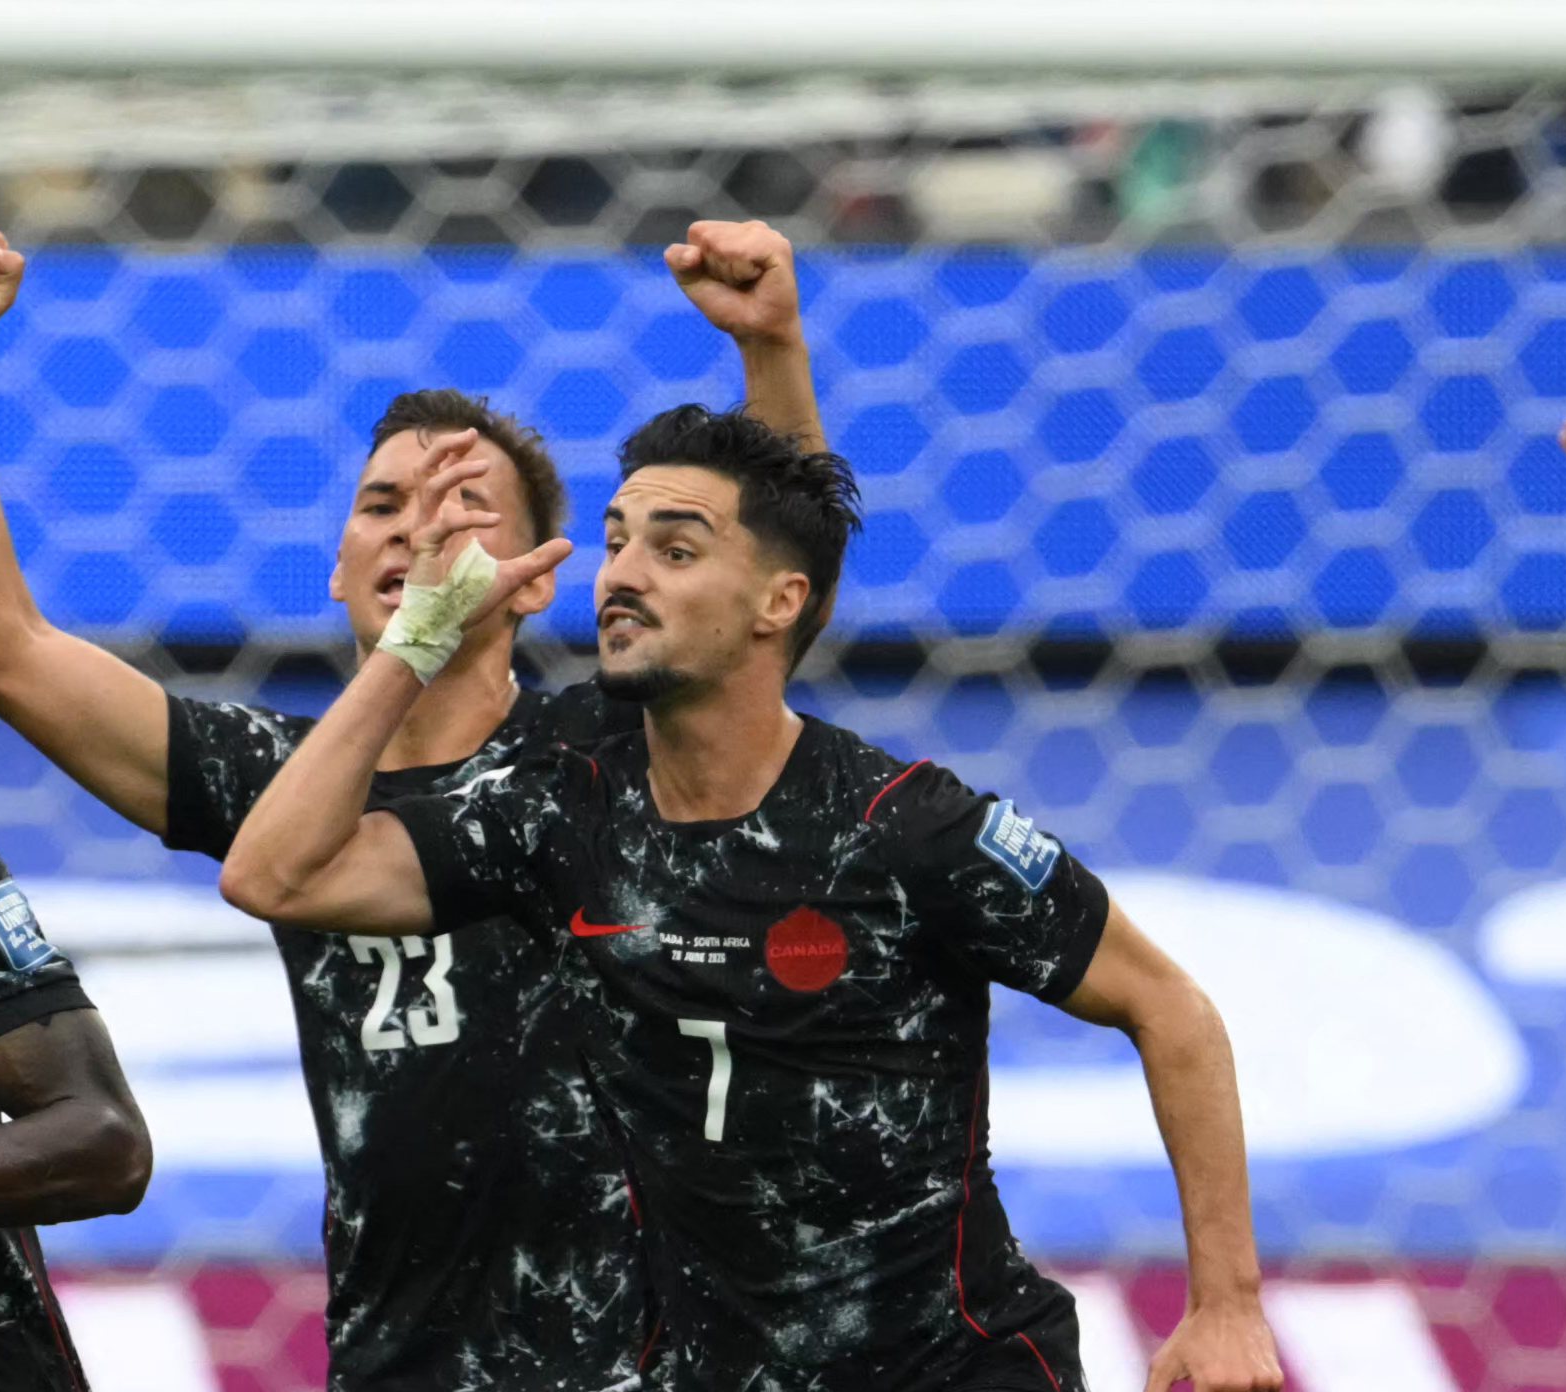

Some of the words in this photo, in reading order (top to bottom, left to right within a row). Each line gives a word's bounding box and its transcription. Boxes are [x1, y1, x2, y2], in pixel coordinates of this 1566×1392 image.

[348, 932, 463, 1051] 23
[769, 944, 844, 958] CANADA
[678, 1019, 732, 1142] 7
